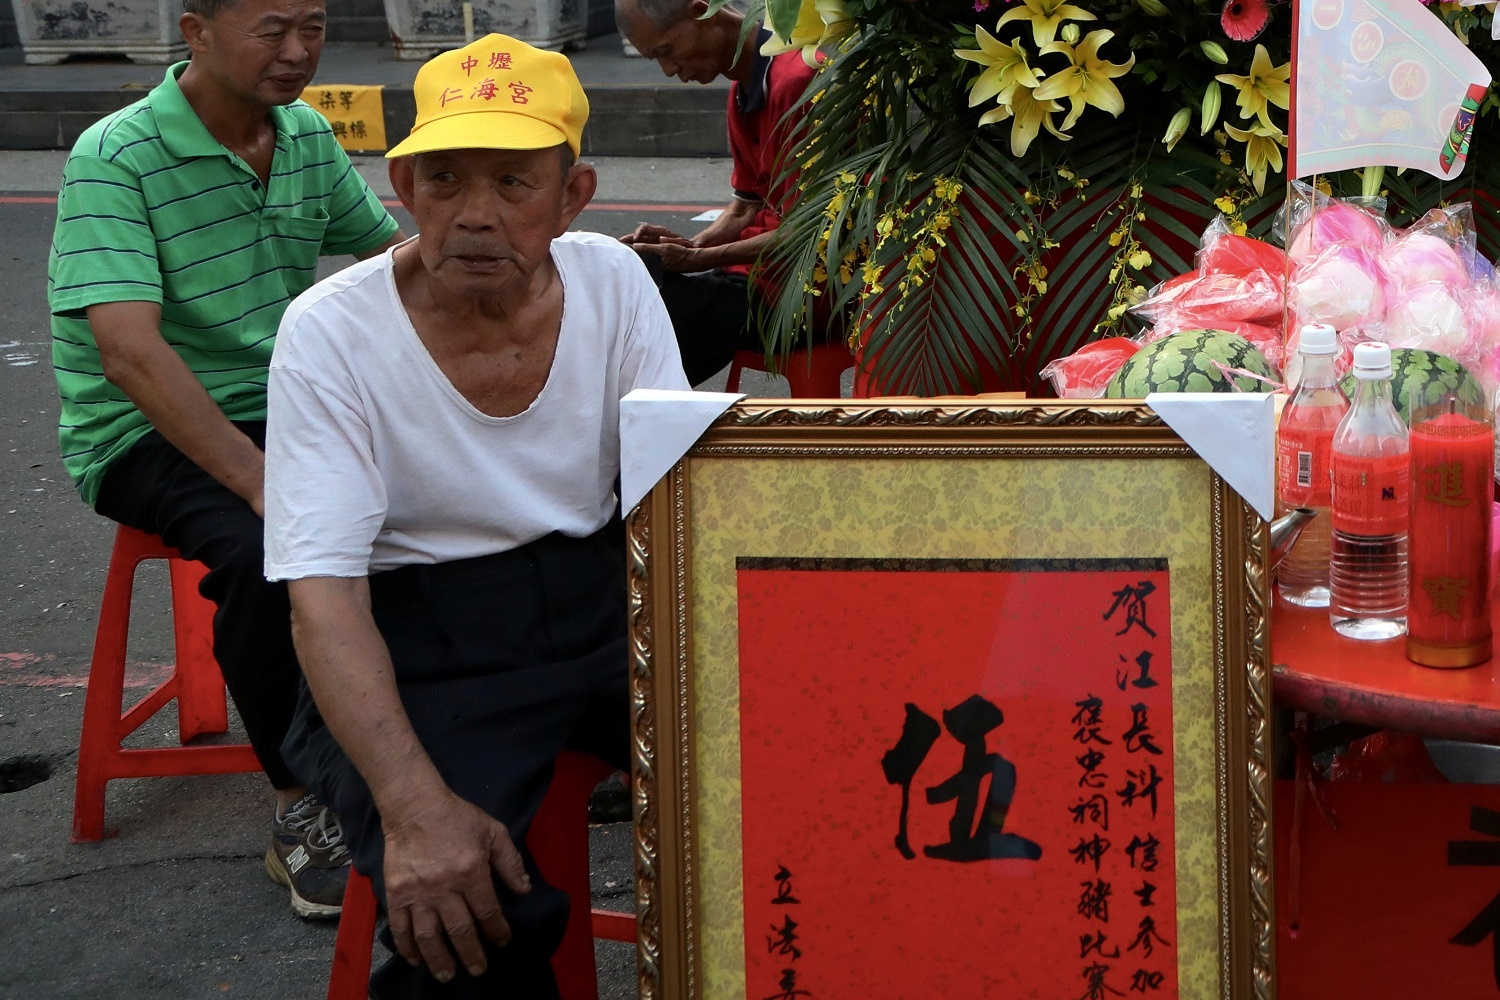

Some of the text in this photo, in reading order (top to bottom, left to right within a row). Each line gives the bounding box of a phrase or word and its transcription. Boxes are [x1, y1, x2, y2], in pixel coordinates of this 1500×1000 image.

[460, 52, 514, 78] 中壢
[439, 78, 535, 109] 仁海宮
[879, 693, 1043, 865] 伍
